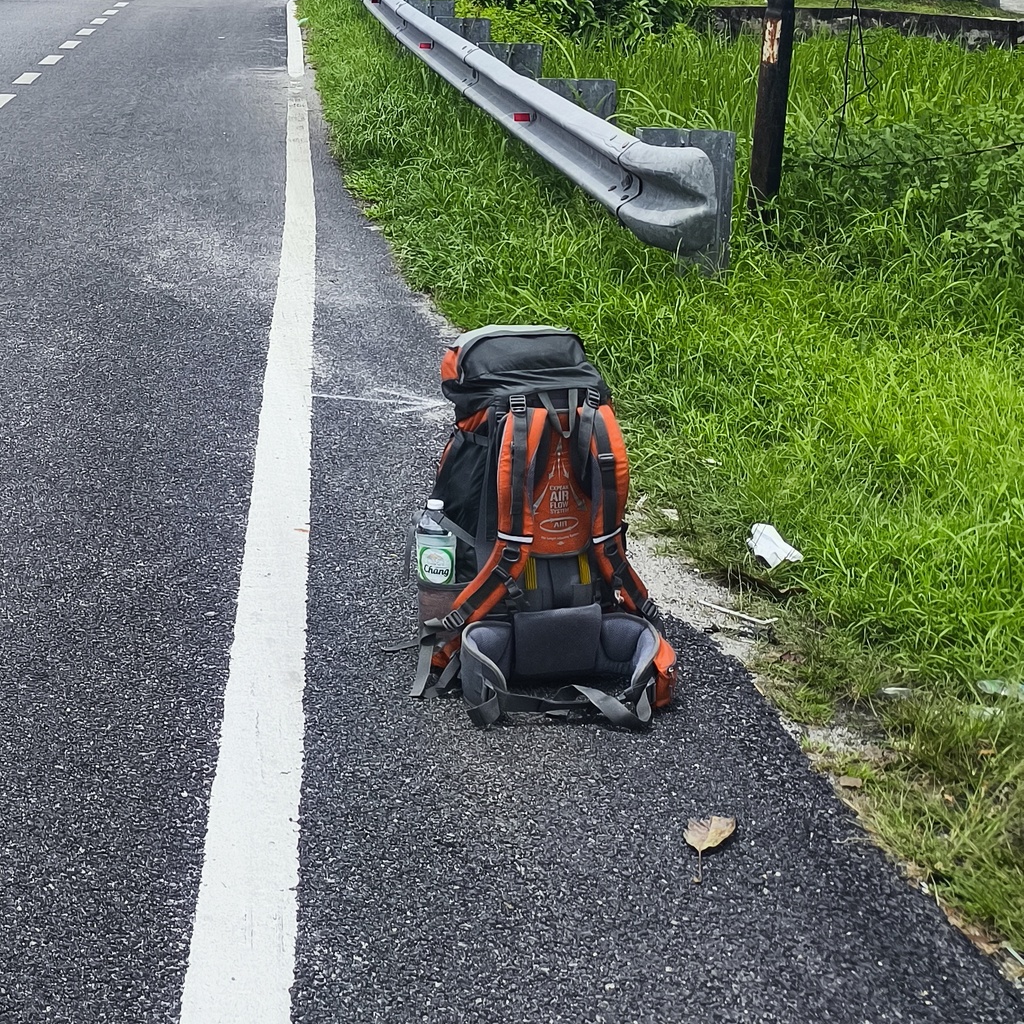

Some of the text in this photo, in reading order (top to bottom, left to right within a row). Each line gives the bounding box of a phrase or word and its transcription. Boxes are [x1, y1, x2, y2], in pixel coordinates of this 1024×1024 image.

[549, 490, 569, 502] AIR
[553, 520, 568, 528] AIR
[423, 564, 450, 578] Chang
